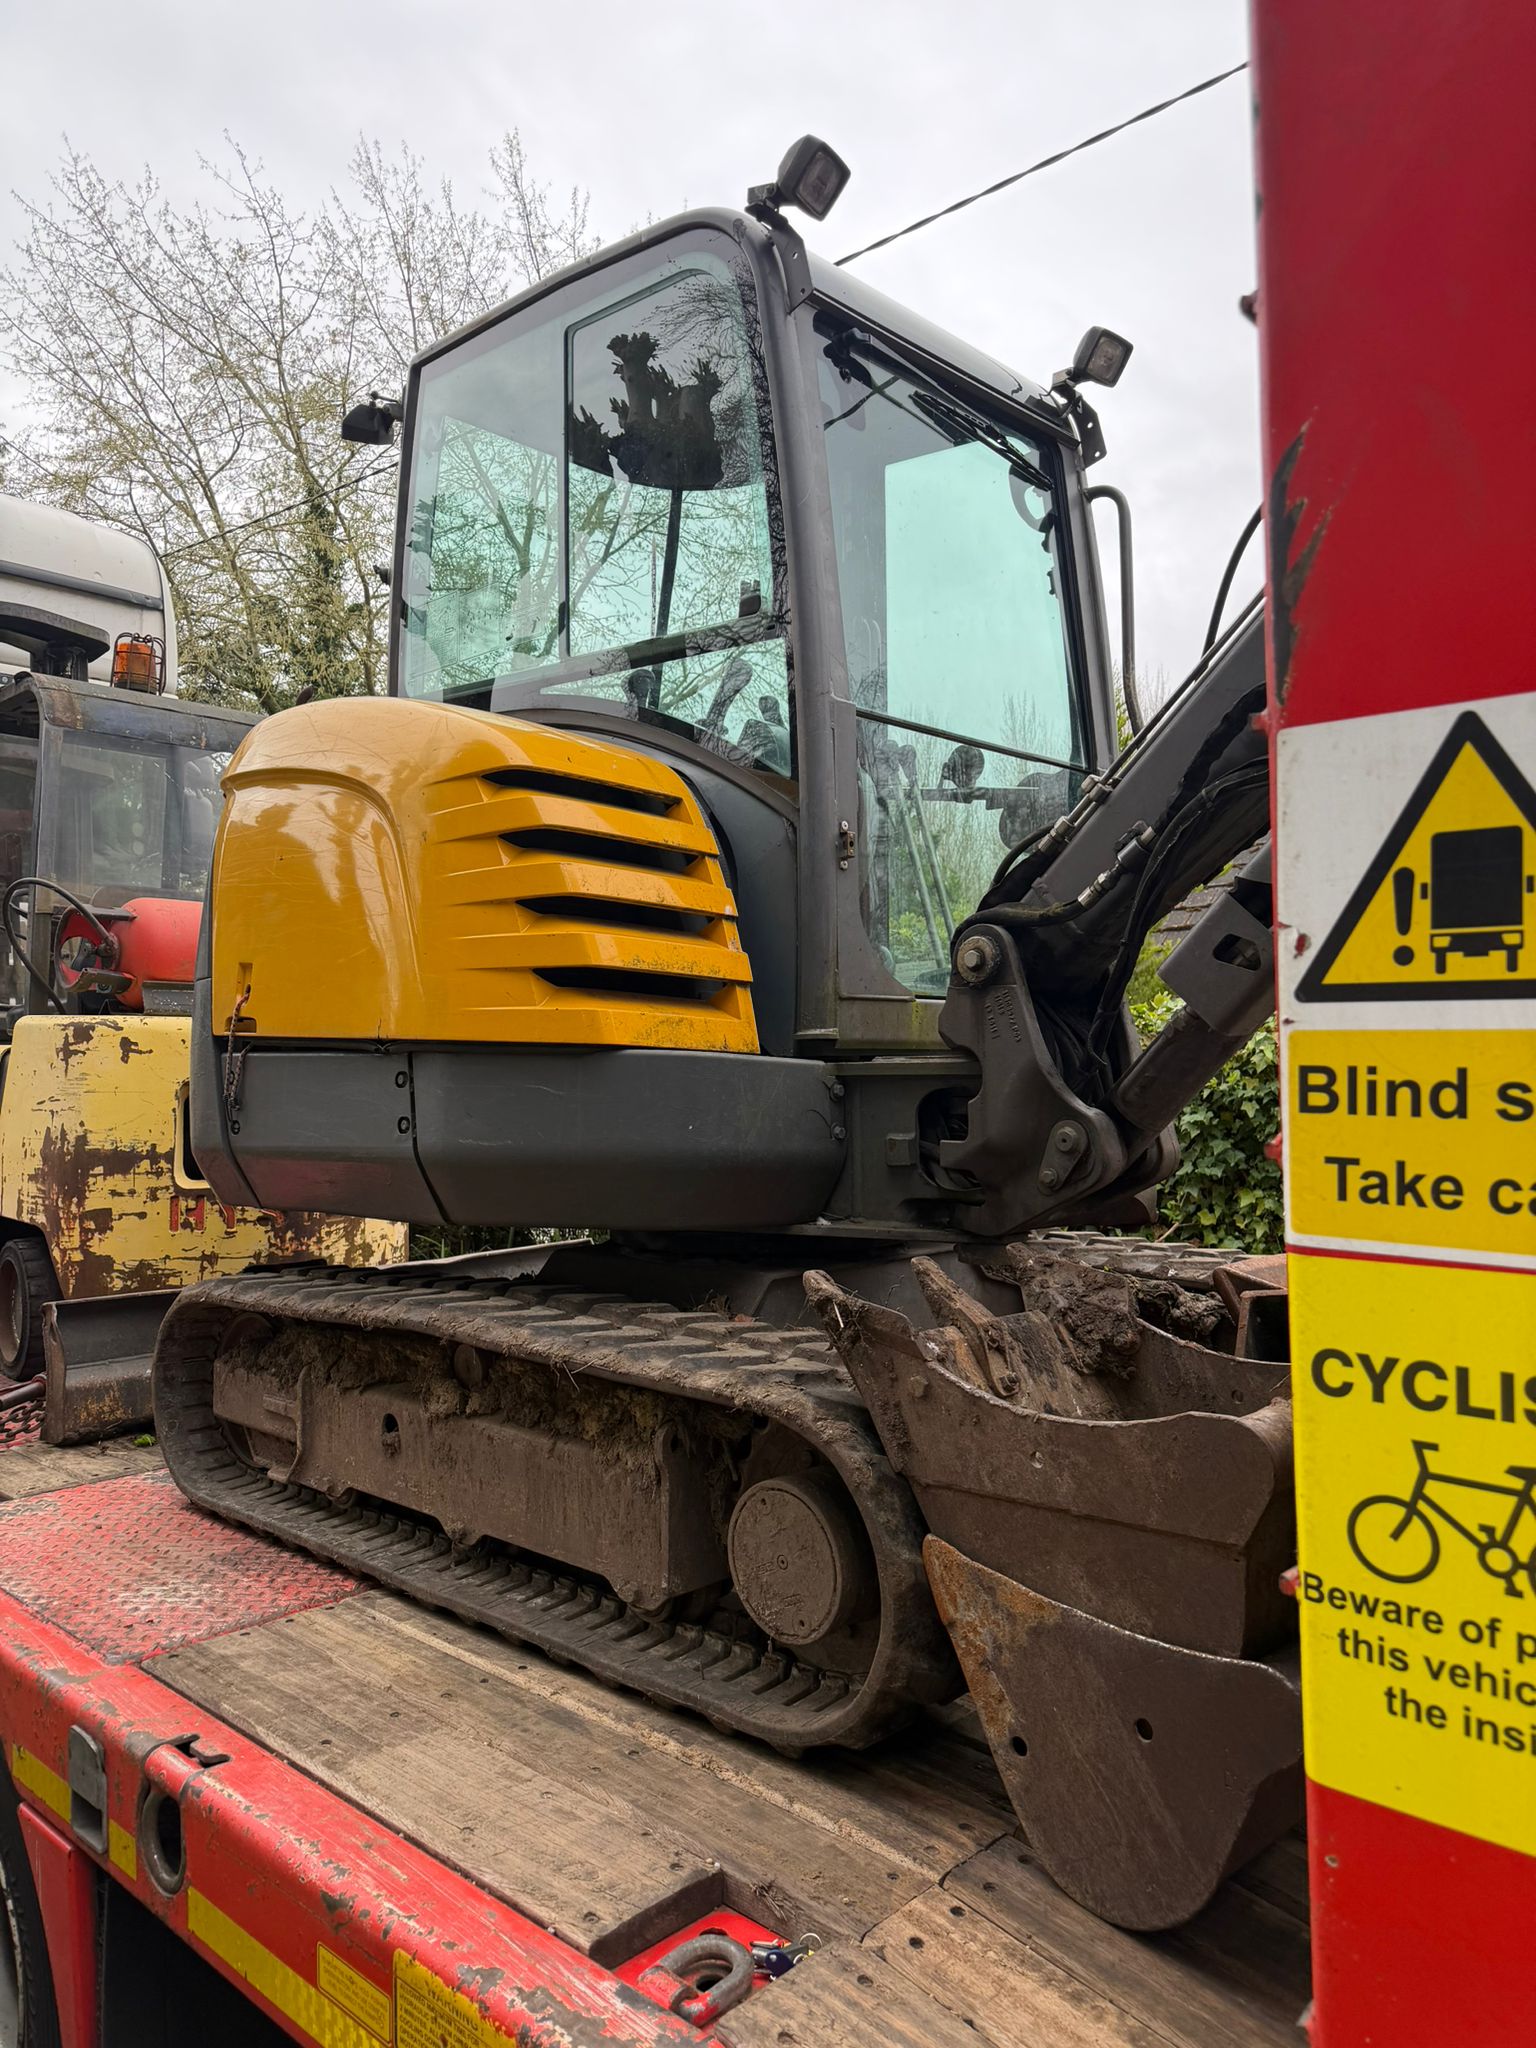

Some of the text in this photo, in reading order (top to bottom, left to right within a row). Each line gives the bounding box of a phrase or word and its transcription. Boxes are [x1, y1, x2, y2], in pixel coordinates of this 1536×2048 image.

[1298, 1065, 1468, 1120] Blind
[1324, 1156, 1536, 1217] Take c
[1303, 1571, 1444, 1635] Beware
[1459, 1617, 1502, 1649] of
[1337, 1627, 1536, 1707] this vehic
[1384, 1686, 1447, 1730] the
